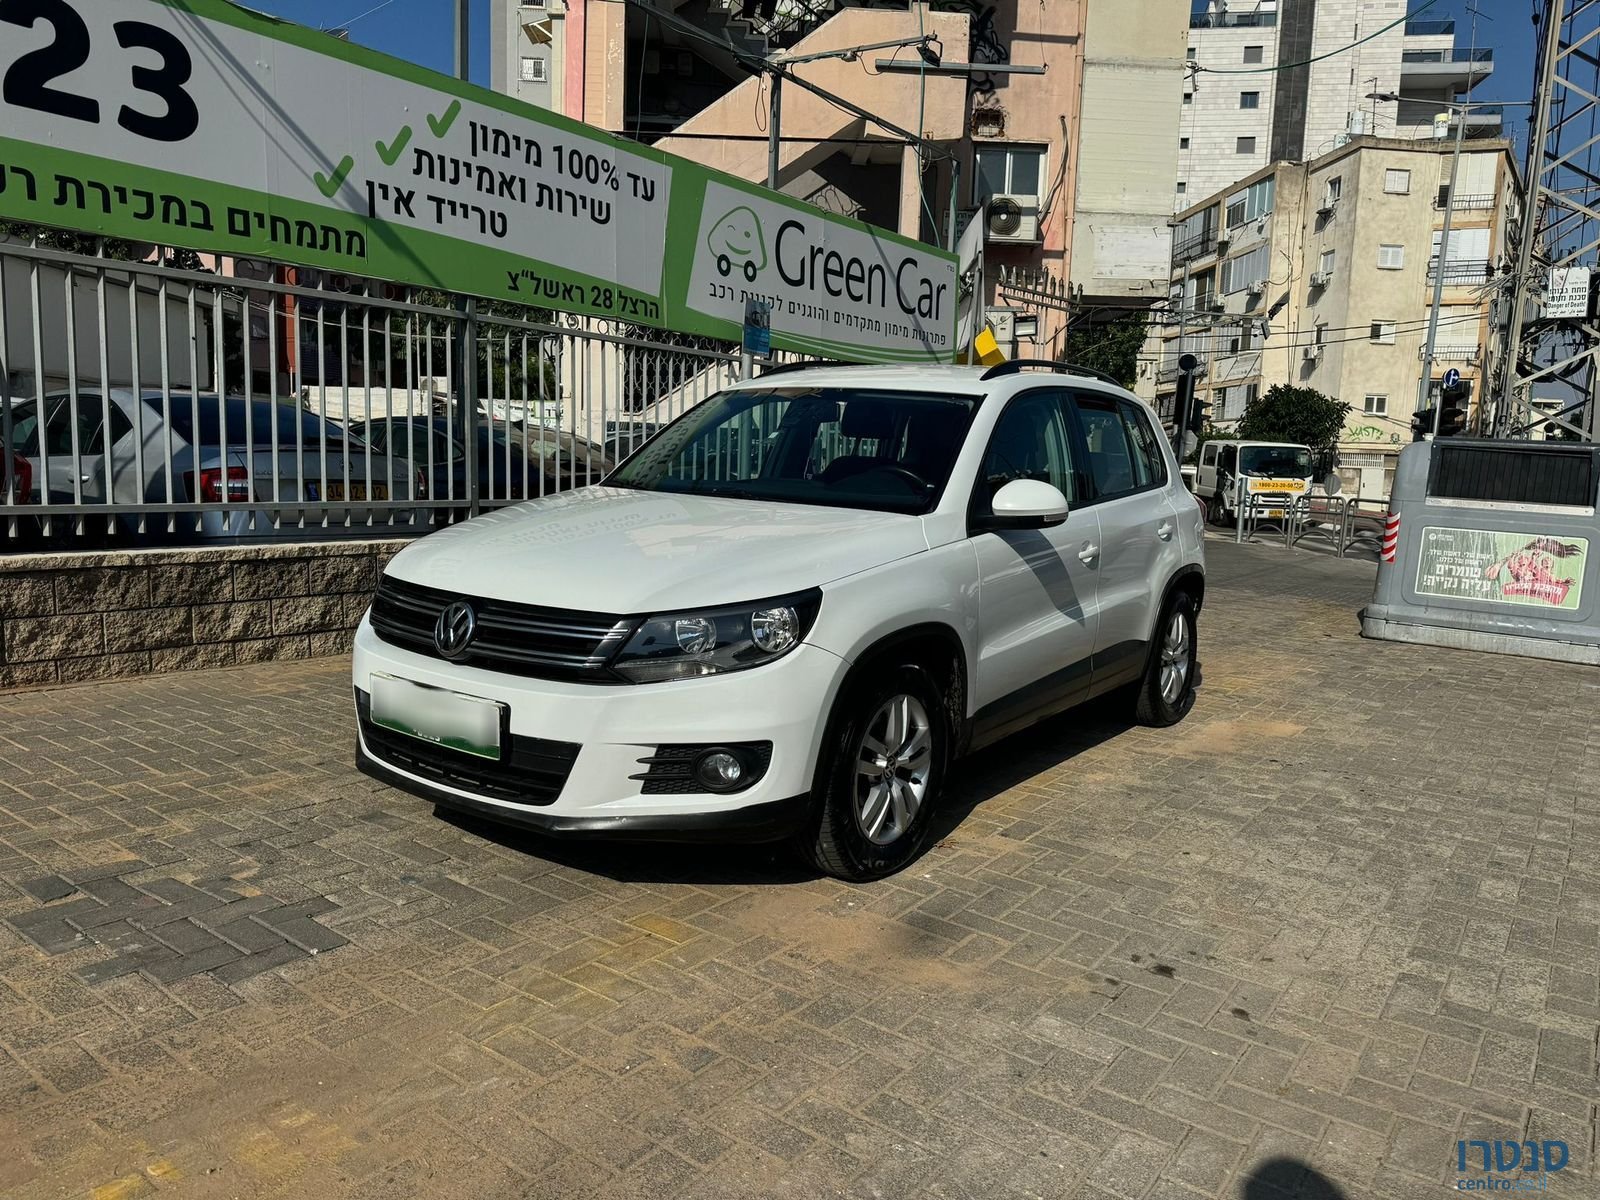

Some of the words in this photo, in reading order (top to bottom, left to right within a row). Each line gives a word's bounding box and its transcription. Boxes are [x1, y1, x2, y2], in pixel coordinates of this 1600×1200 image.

[470, 120, 542, 167] מימון
[413, 147, 526, 203] ואמינות
[552, 145, 620, 192] 100%
[627, 172, 655, 203] עד
[53, 174, 214, 231] במכירת
[365, 179, 416, 220] אין
[427, 194, 508, 238] טרייד
[535, 182, 612, 225] שירות
[227, 206, 367, 258] מתמחים
[775, 219, 886, 309] Green
[895, 257, 947, 321] Car
[591, 285, 613, 309] 28
[618, 290, 659, 319] הרצל
[709, 282, 735, 301] רכב
[788, 303, 829, 322] והוגנים
[833, 311, 881, 333] מתקדמים
[884, 322, 909, 338] מימון
[911, 327, 947, 346] פתרונות
